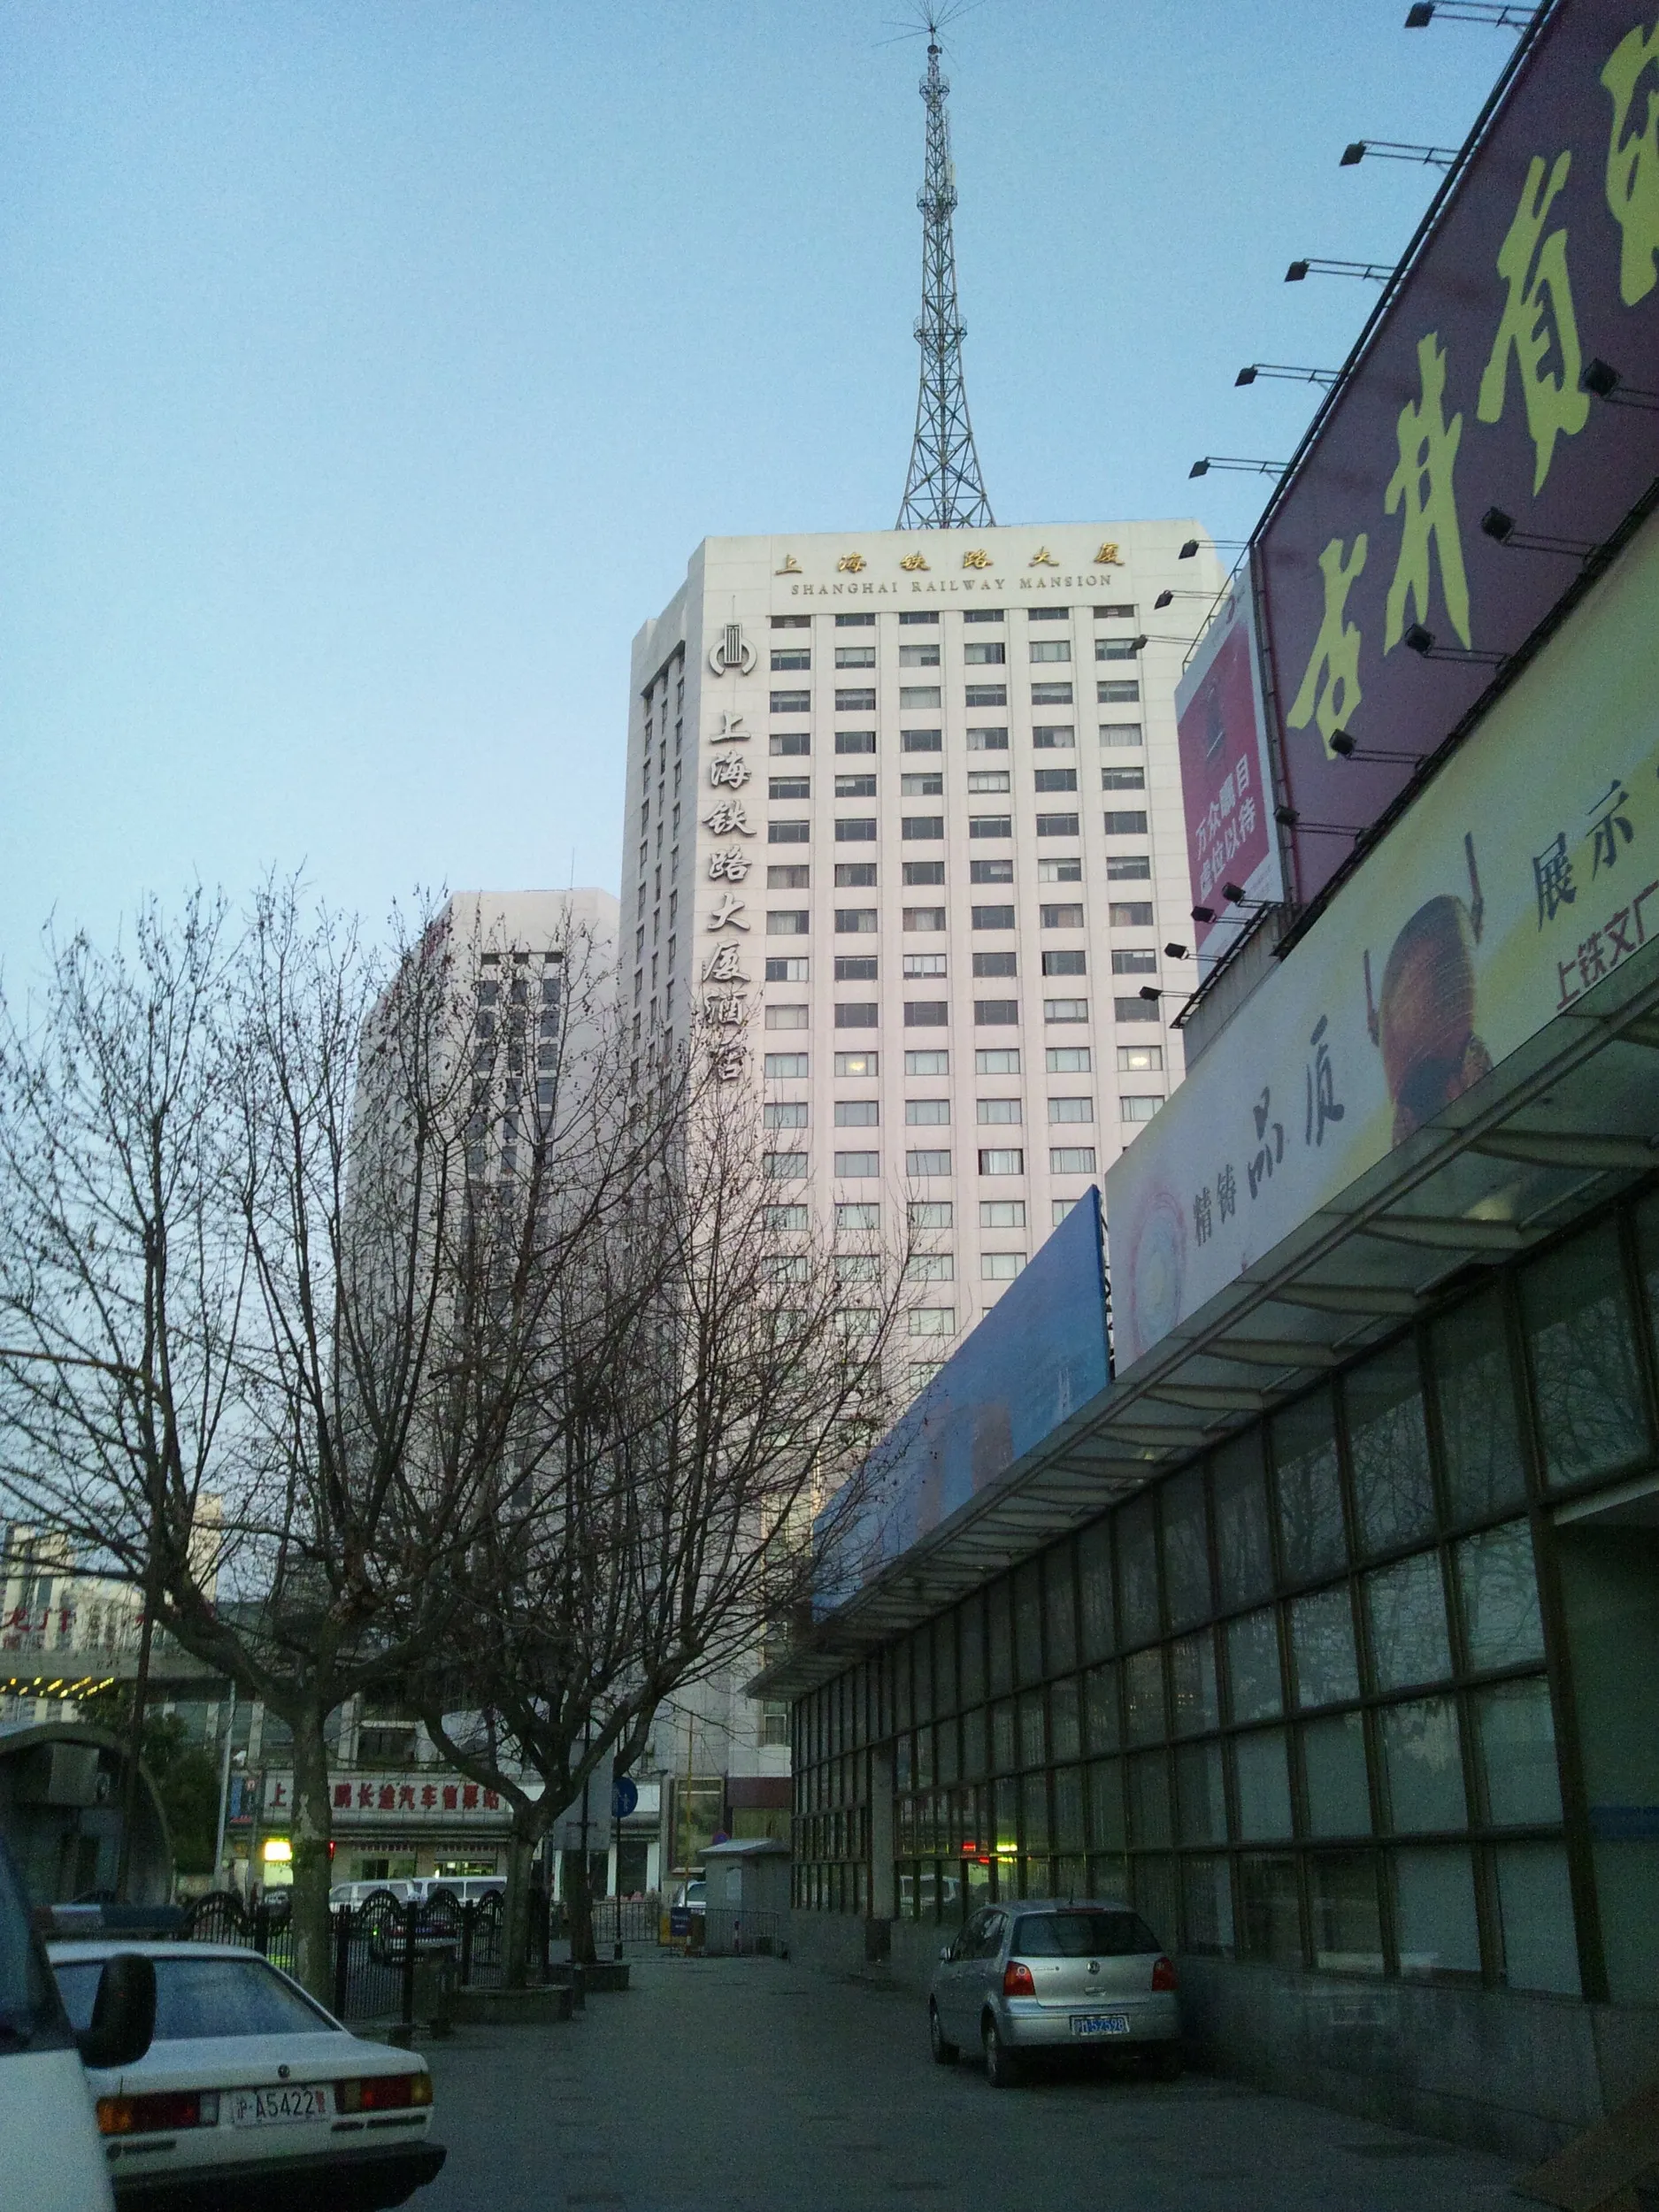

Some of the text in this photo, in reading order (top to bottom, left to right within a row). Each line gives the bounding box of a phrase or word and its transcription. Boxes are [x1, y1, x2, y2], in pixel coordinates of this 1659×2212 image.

[775, 542, 1125, 576] 上海铁路大厦
[791, 574, 1112, 595] SHANGHAI RAILWAY MANSION
